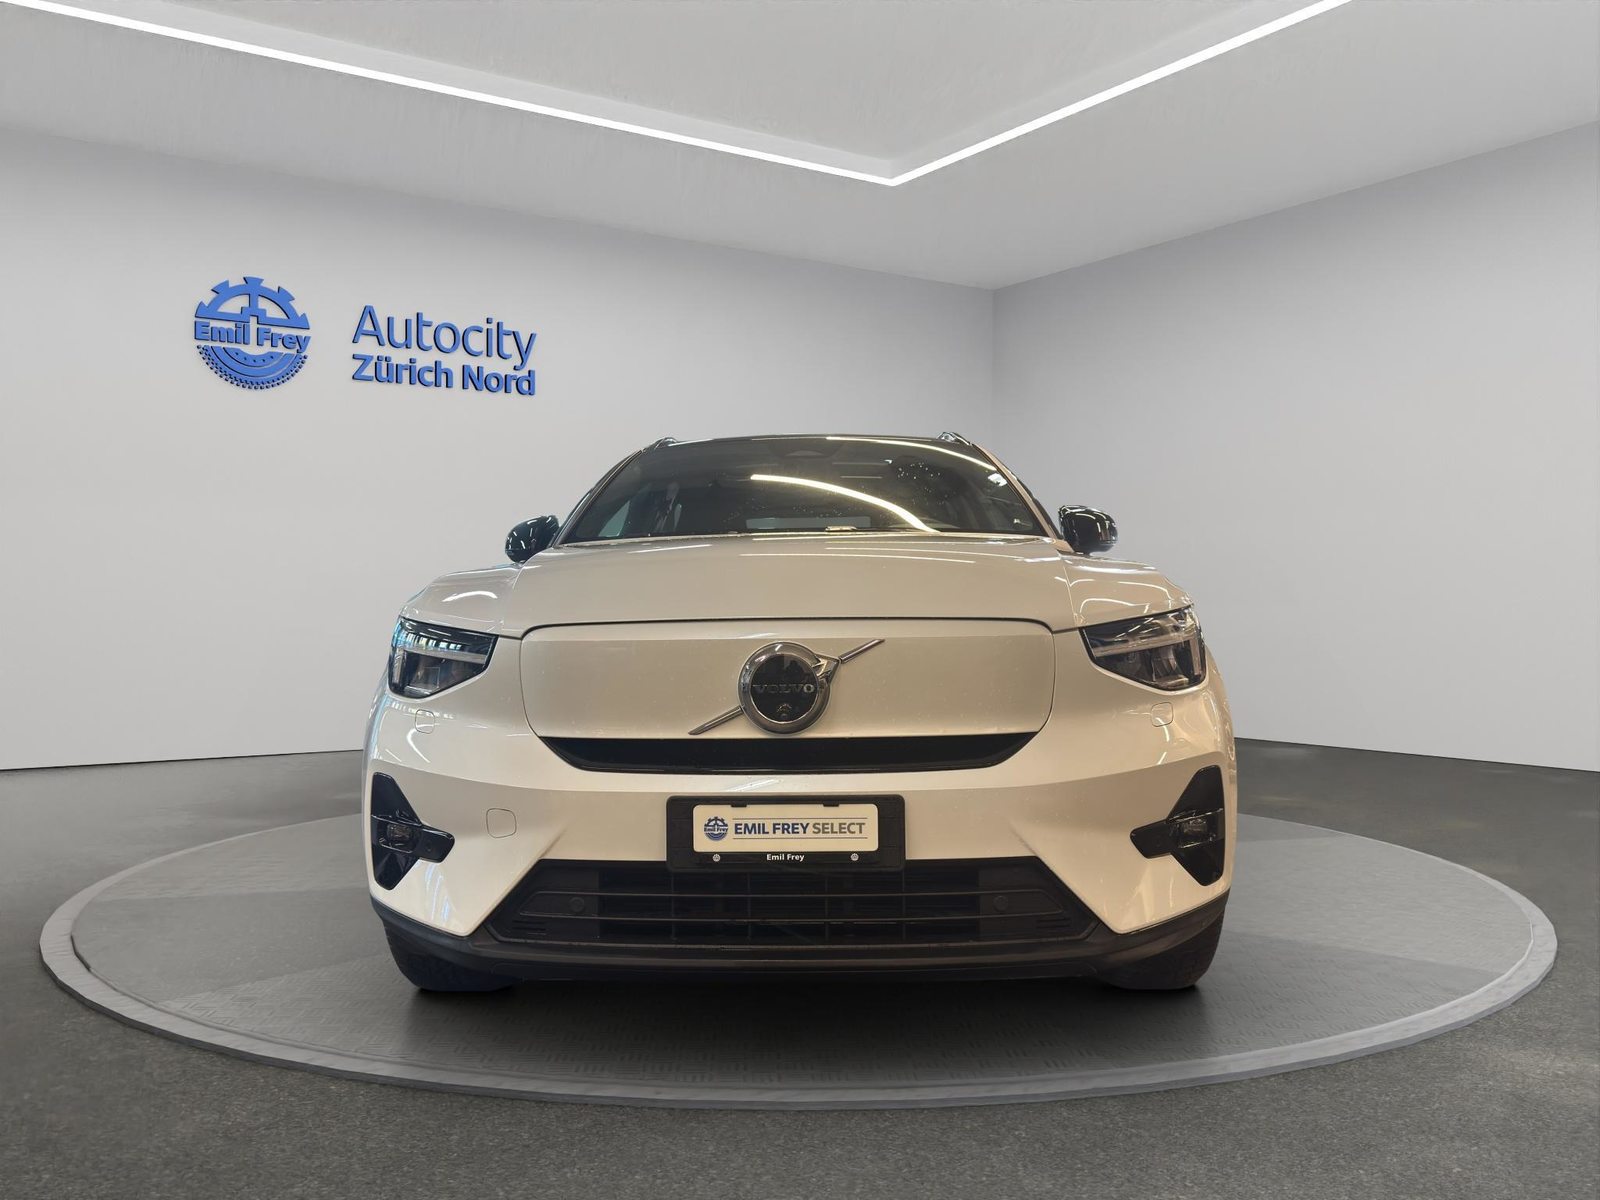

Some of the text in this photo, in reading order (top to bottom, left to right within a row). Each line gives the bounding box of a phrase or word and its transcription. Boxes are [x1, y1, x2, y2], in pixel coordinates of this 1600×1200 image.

[194, 319, 311, 353] Emil Frey
[352, 304, 537, 370] Autocity
[352, 353, 536, 396] Zürich Nord
[752, 683, 815, 693] VOLVO
[734, 822, 865, 834] EMIL FREY SELECT
[766, 853, 805, 862] Emil Frey
